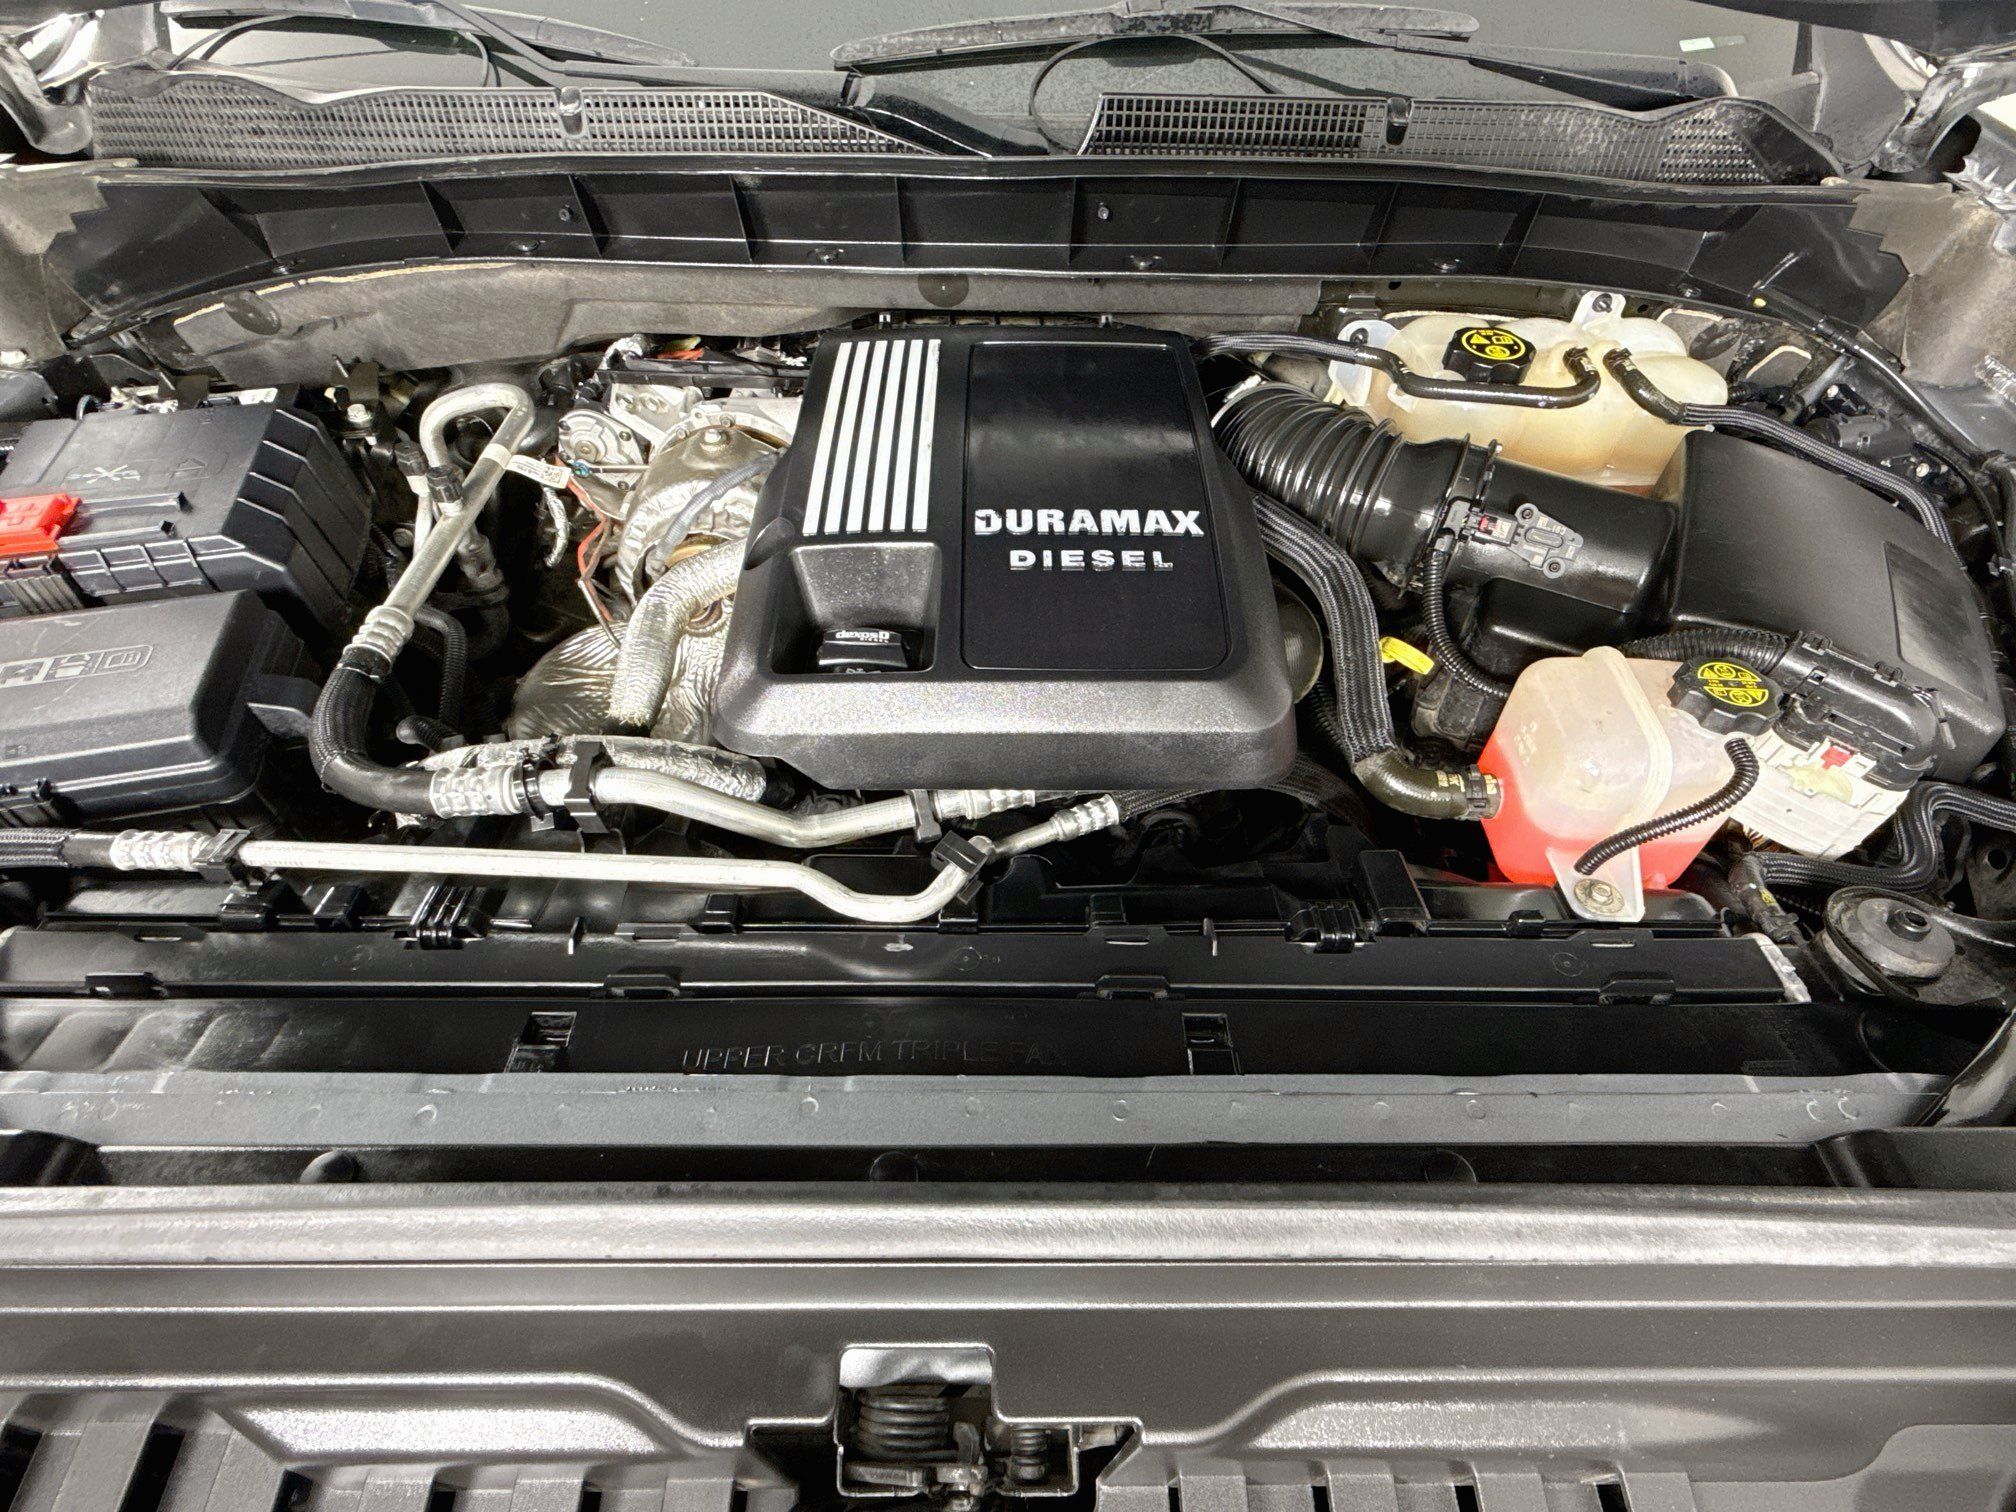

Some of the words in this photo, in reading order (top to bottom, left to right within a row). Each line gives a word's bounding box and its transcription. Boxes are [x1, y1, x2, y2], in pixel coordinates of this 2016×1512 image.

[974, 509, 1205, 537] DURAMAX
[1009, 550, 1174, 572] DIESEL
[682, 1045, 785, 1070] UPPER
[890, 1040, 999, 1062] TRIPLE
